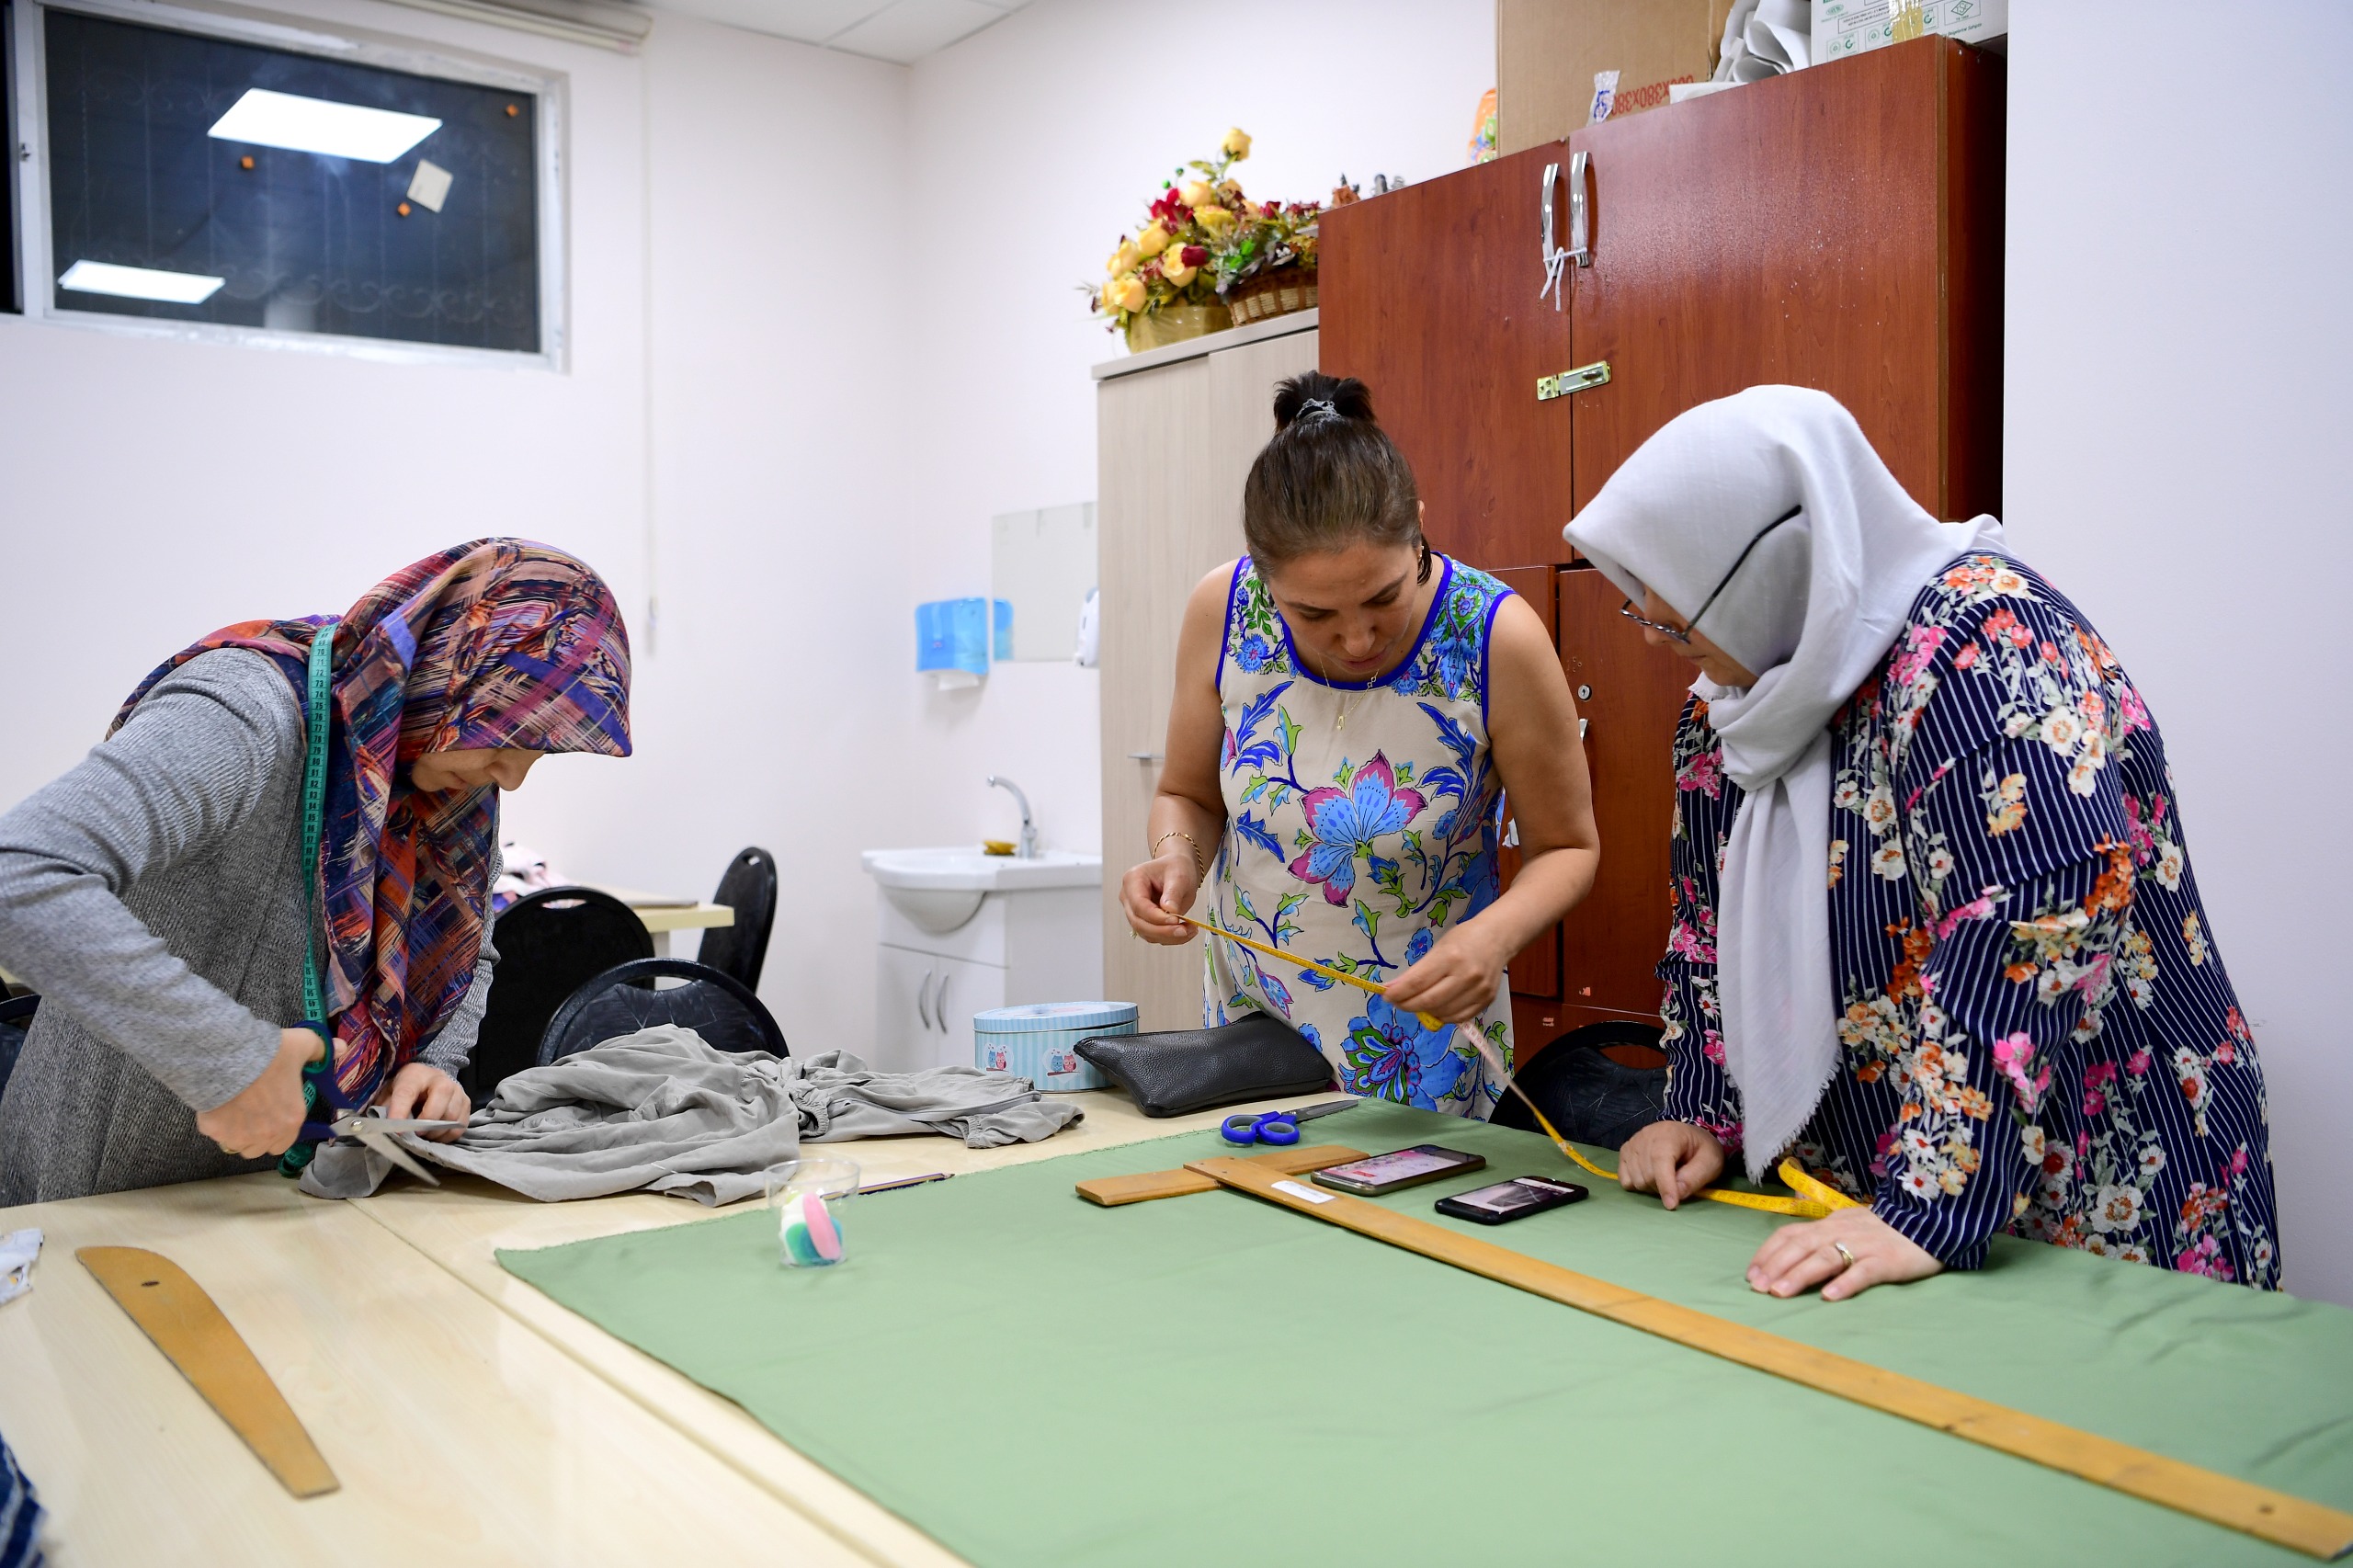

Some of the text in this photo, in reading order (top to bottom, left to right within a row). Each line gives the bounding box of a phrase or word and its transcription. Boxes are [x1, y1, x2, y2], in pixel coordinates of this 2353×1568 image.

[1611, 74, 1694, 117] x380x380
[315, 712, 324, 721] 76
[314, 723, 323, 732] 77
[313, 746, 322, 755] 79
[313, 757, 321, 766] 80
[311, 768, 319, 777] 81
[310, 779, 319, 788] 82
[309, 790, 318, 799] 83
[309, 801, 317, 810] 84
